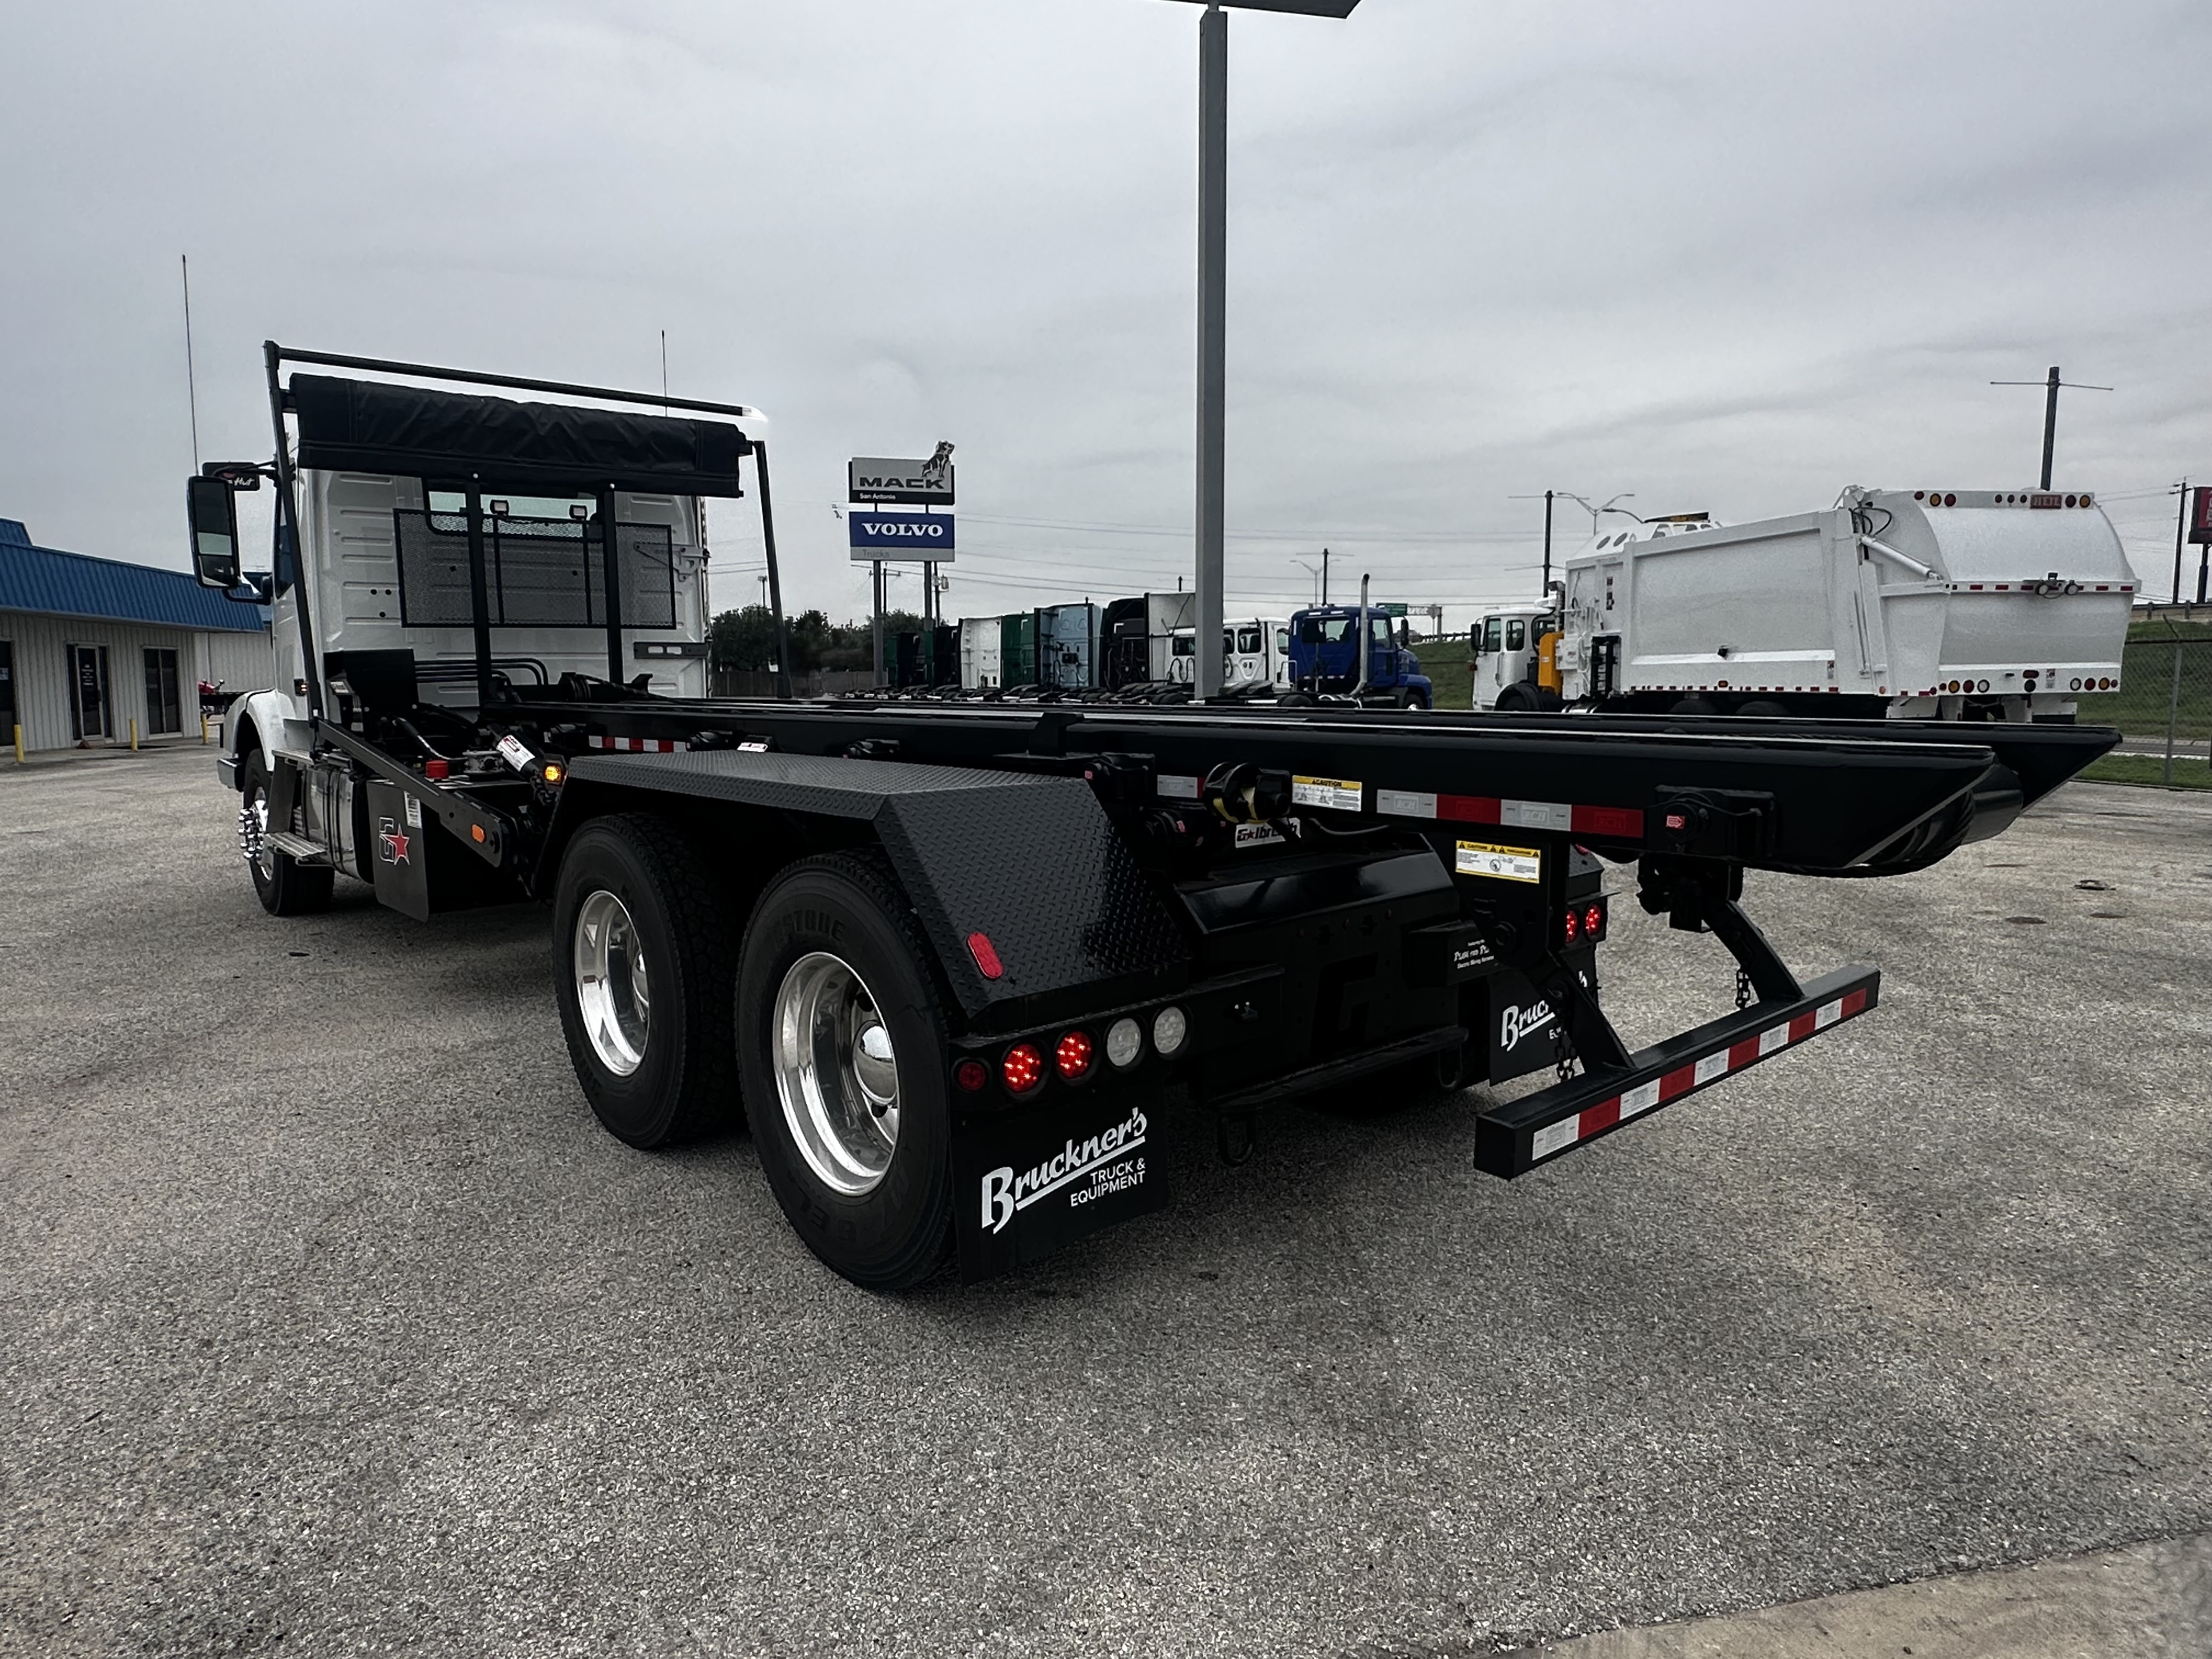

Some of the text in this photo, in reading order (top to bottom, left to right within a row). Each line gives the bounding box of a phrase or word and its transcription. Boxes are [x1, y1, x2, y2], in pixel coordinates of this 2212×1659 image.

[859, 477, 944, 489] MACK
[861, 522, 944, 537] VOLVO
[862, 549, 889, 558] Trucks
[981, 1107, 1147, 1234] Bruckner's
[1090, 1158, 1147, 1185] TRUCK &
[1070, 1171, 1146, 1206] EQUIPMENT
